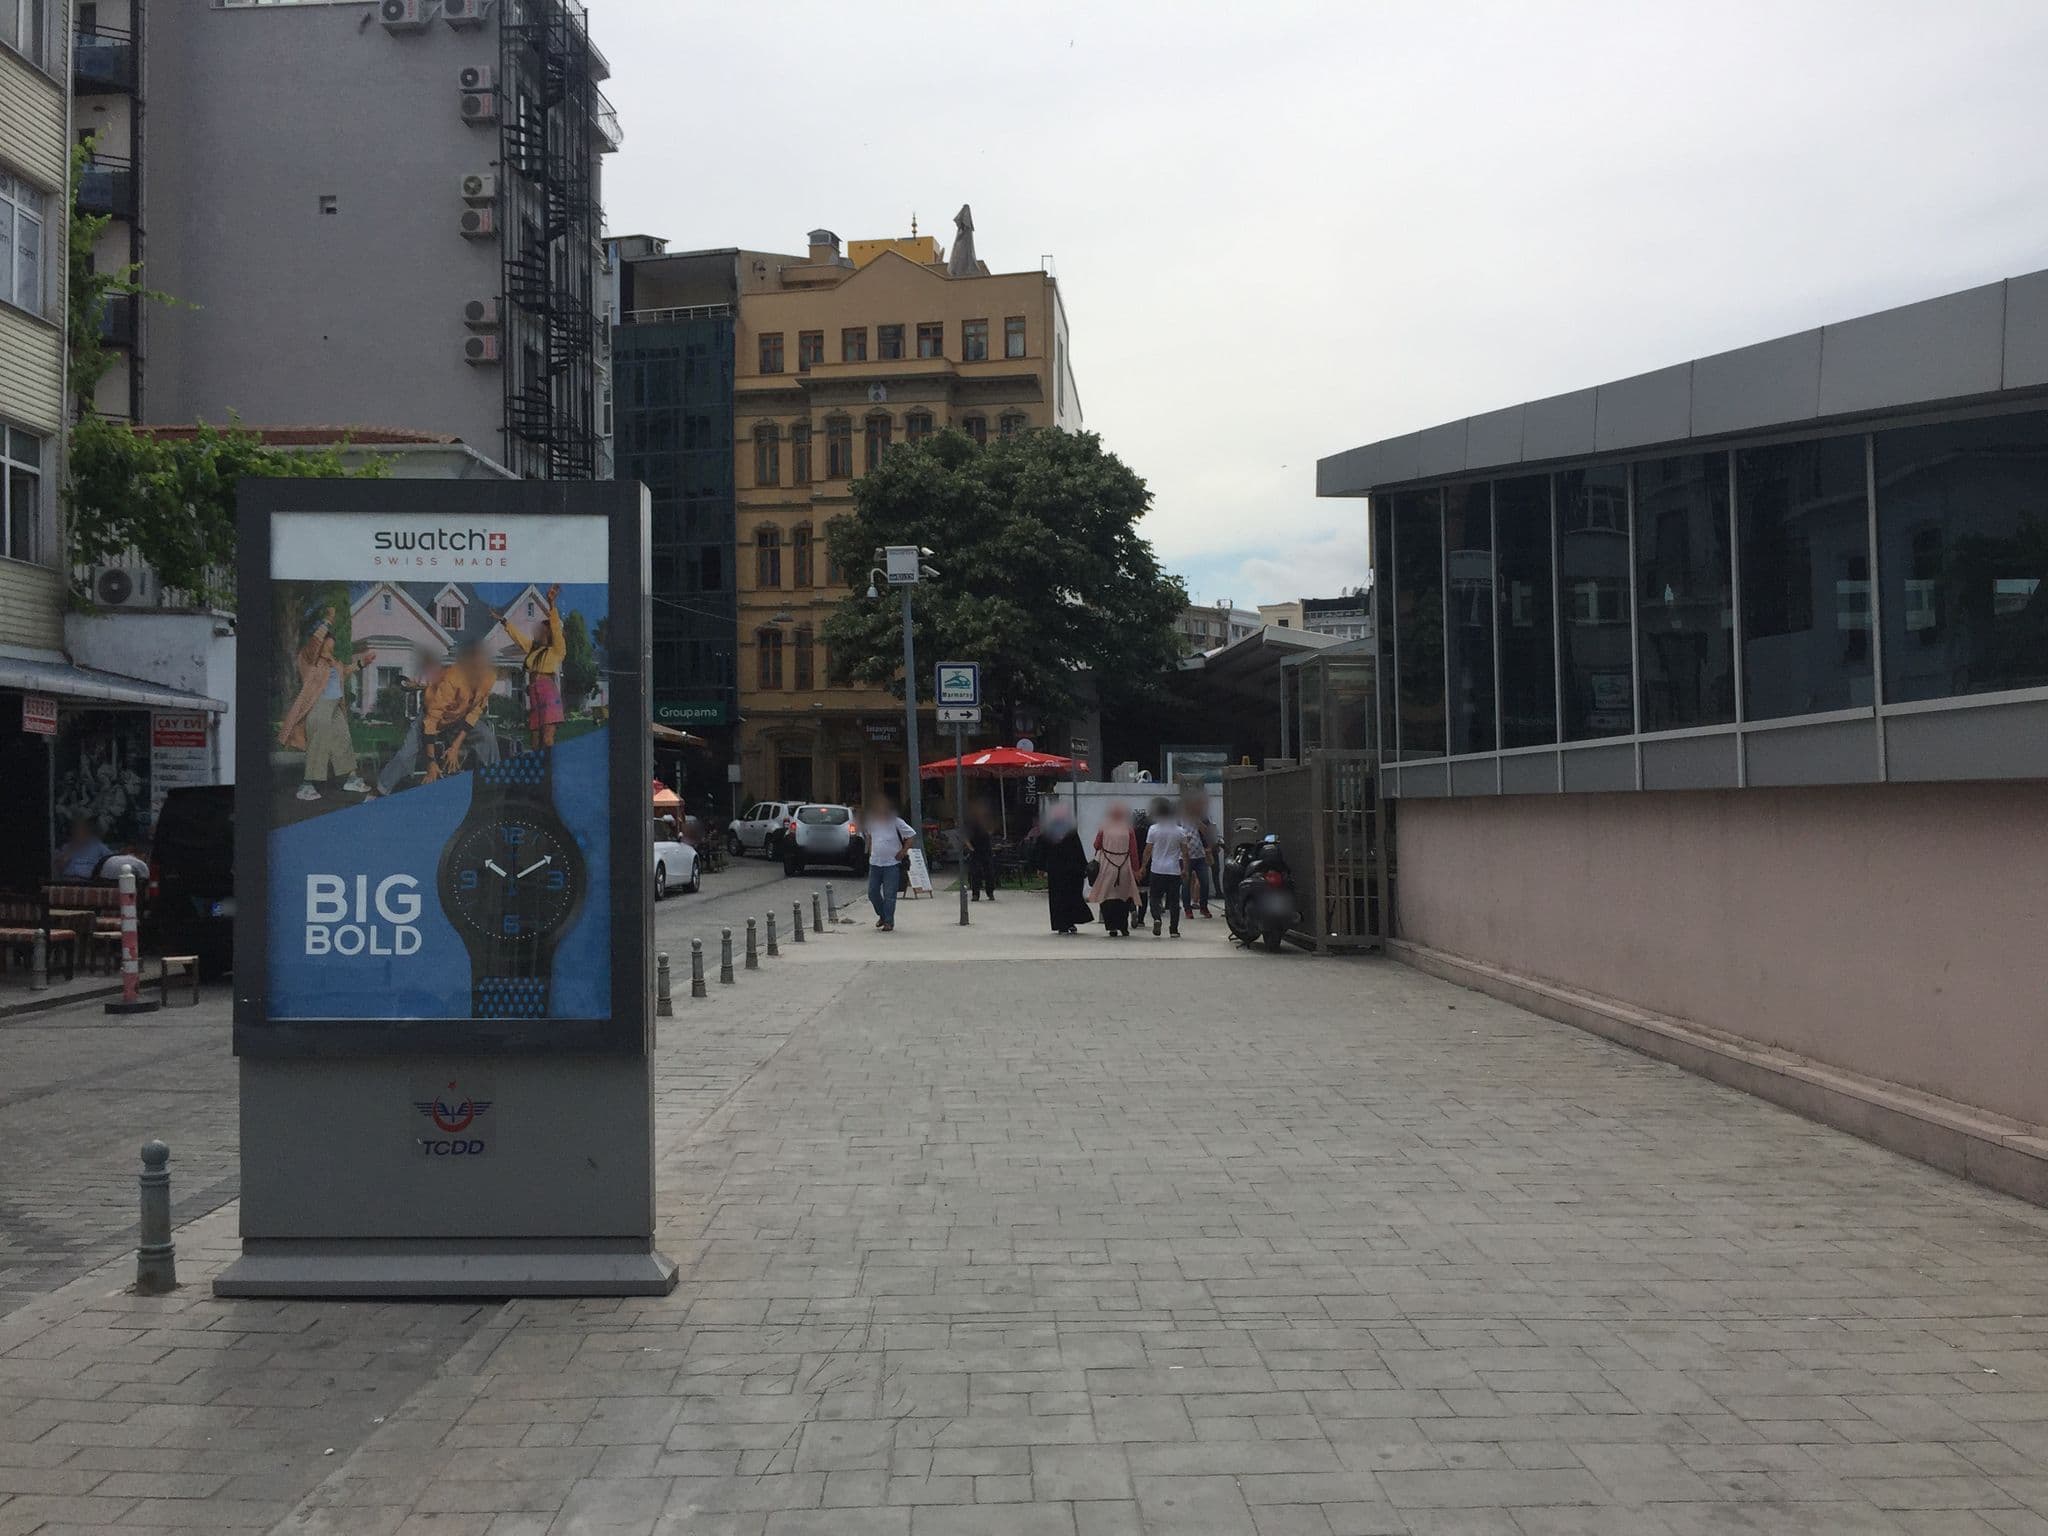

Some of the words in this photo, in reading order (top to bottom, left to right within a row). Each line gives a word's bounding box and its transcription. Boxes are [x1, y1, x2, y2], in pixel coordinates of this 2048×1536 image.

[374, 528, 486, 551] swatch
[374, 556, 438, 567] SWISS
[455, 557, 508, 567] MADE
[659, 706, 718, 719] Groupama
[306, 873, 422, 924] BIG
[305, 924, 423, 956] BOLD
[423, 1140, 485, 1156] TCDD
